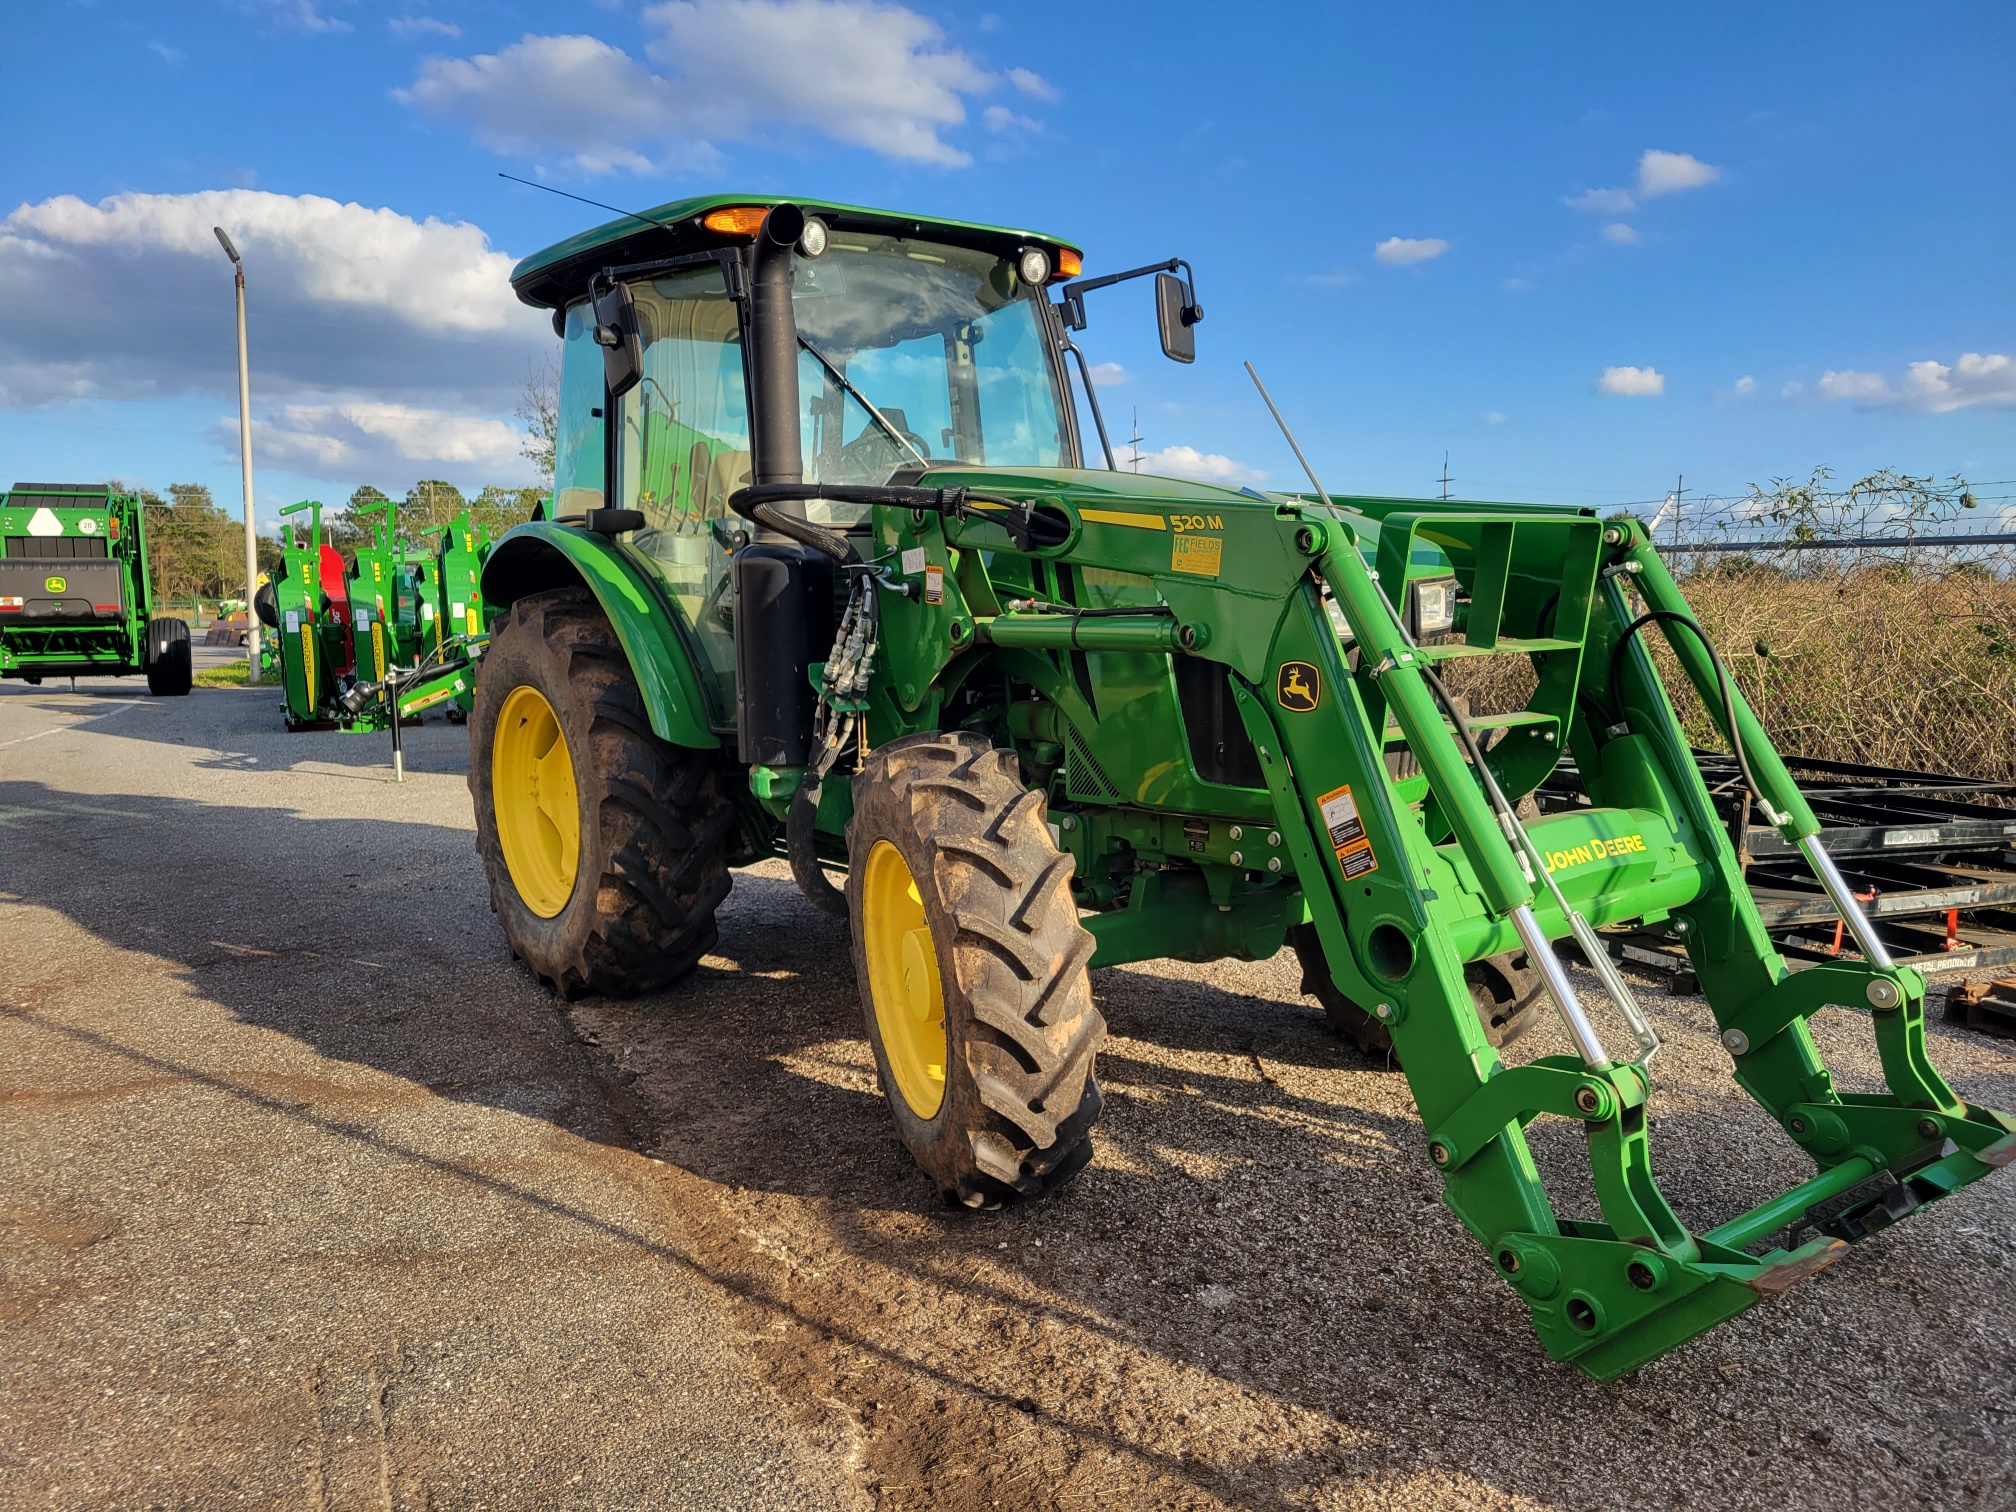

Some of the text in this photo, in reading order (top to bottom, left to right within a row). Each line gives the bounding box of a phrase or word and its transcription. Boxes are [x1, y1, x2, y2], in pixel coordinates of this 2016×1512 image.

[1169, 514, 1225, 533] 520 M
[1173, 538, 1189, 554] FEC
[1190, 539, 1220, 551] FIELDS
[301, 629, 312, 675] JOHN DEERE
[372, 627, 382, 673] JOHN DEERE
[1346, 842, 1367, 854] WARNING
[1545, 834, 1647, 873] JOHN DEERE
